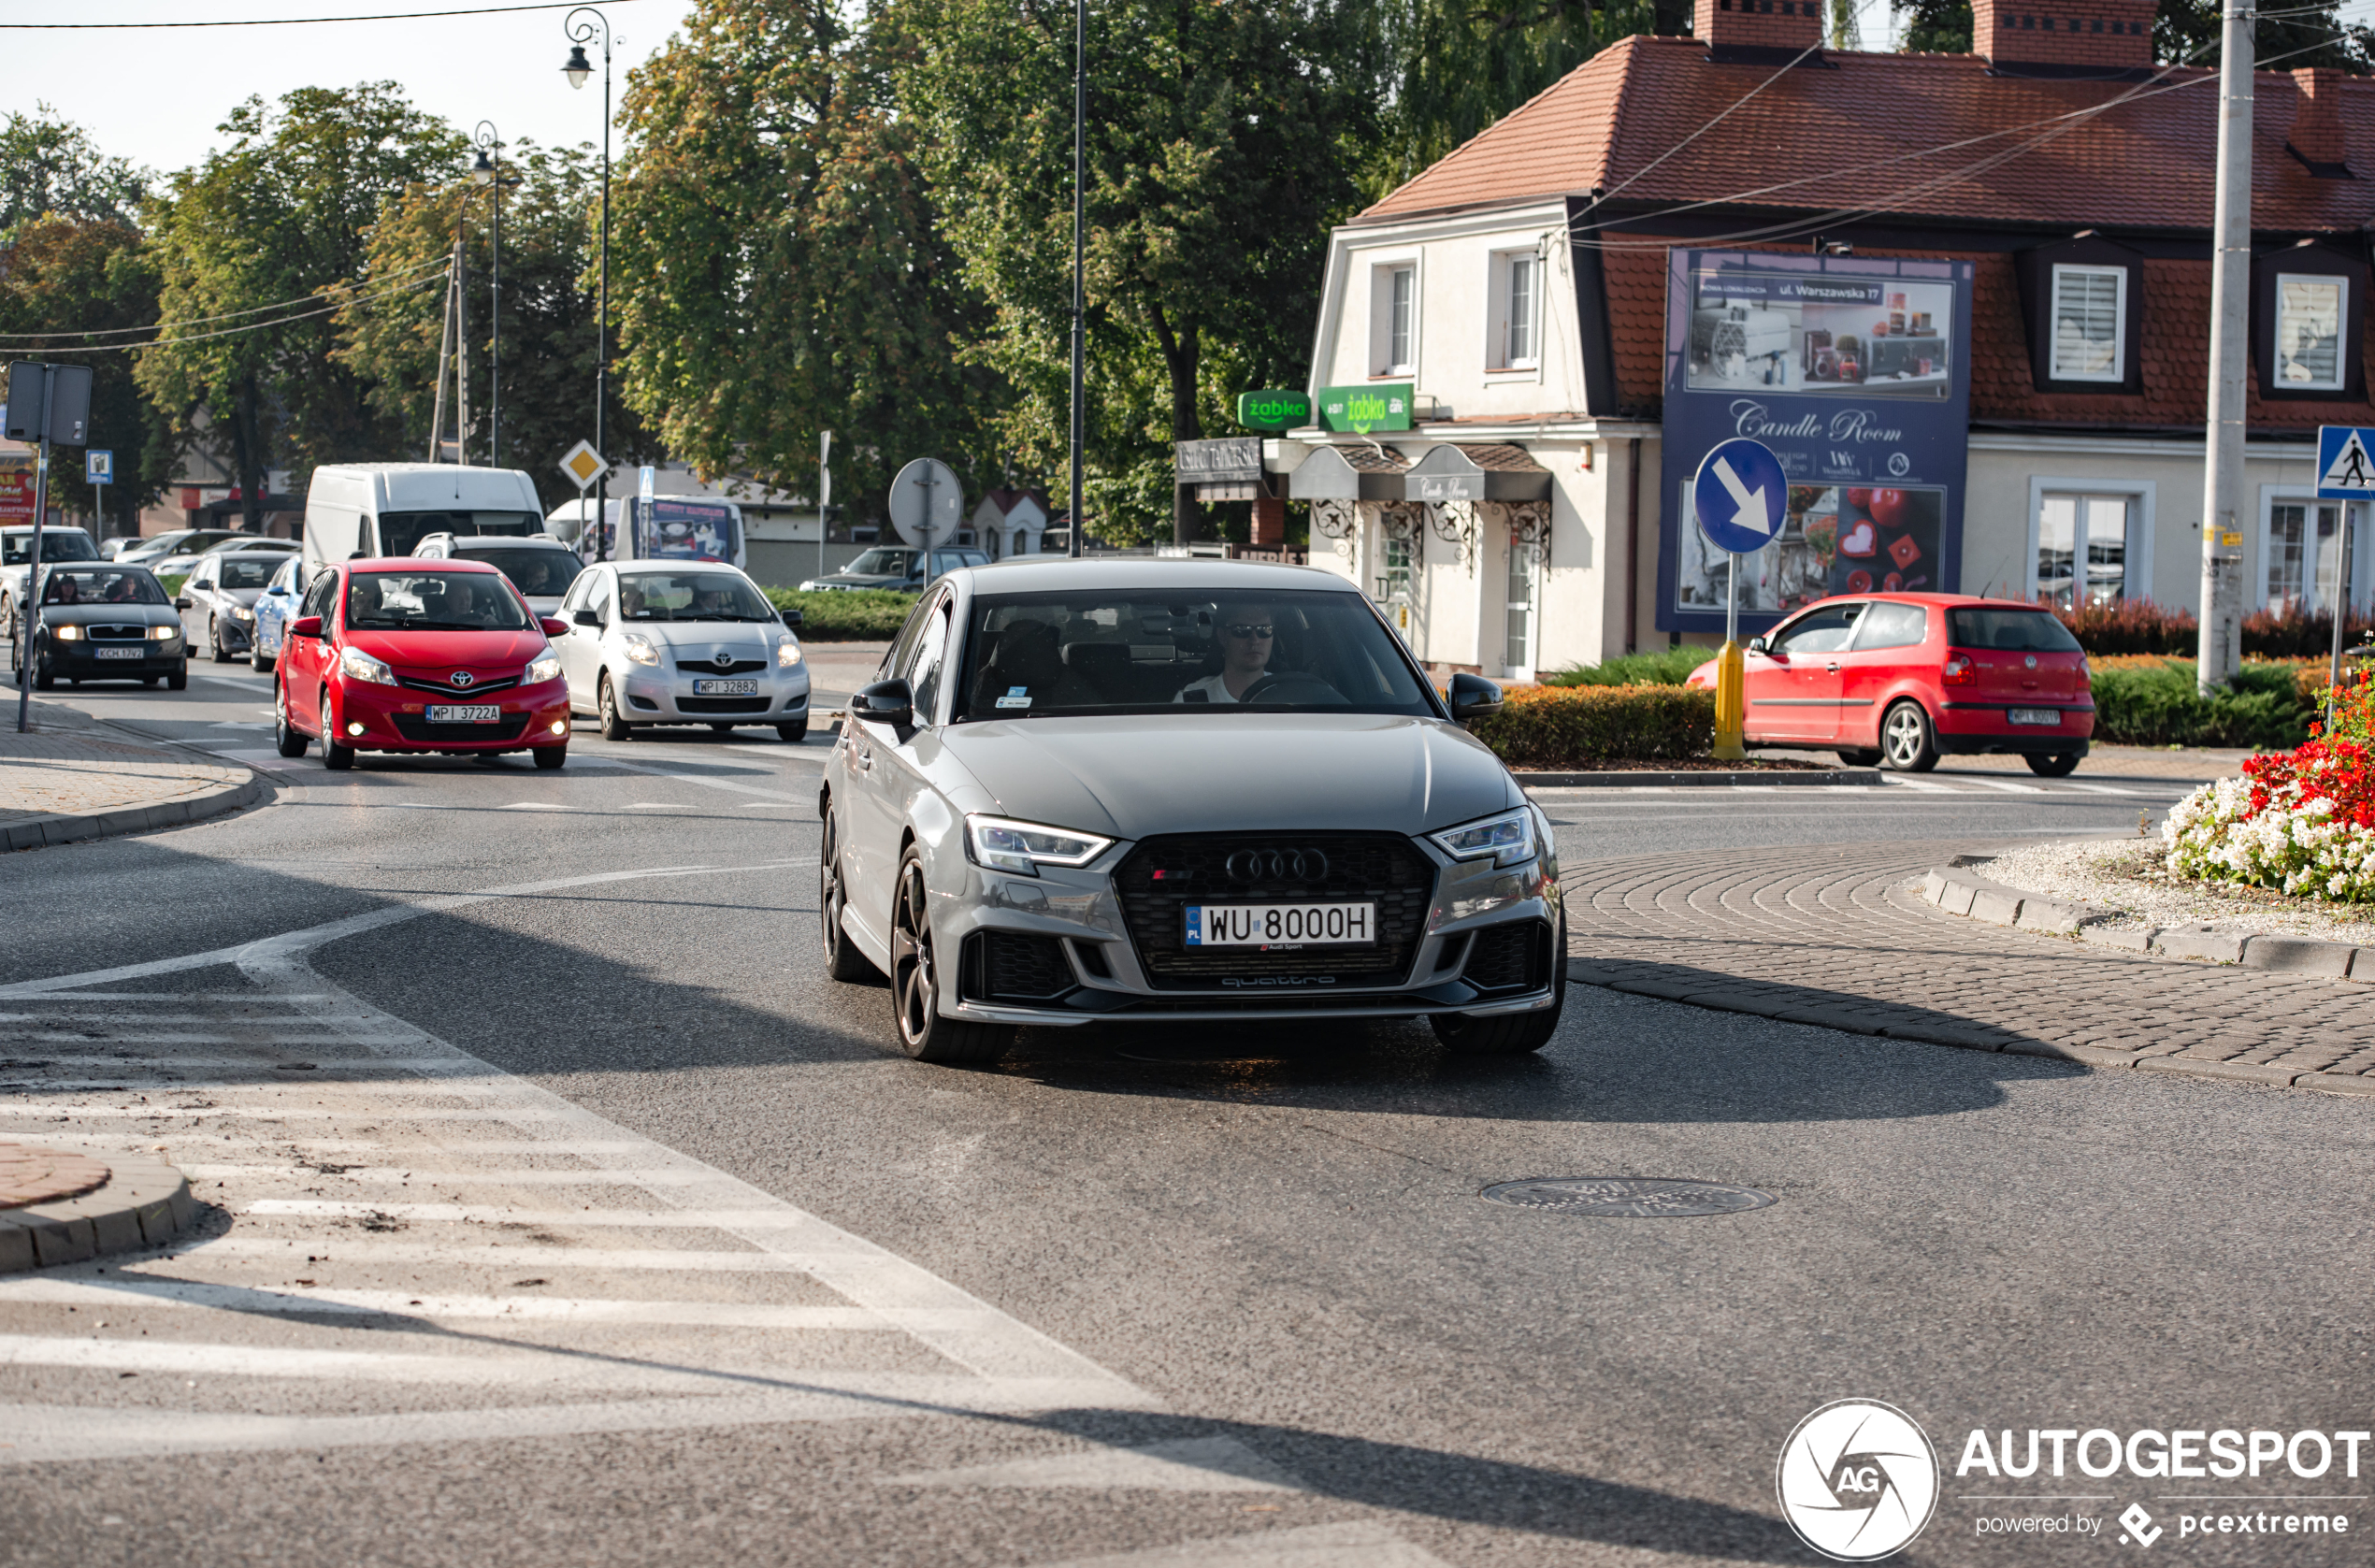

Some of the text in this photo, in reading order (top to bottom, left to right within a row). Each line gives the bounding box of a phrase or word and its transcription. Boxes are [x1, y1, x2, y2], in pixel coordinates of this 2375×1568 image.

[1779, 285, 1879, 299] ul. Warszawska 17
[1249, 399, 1306, 416] żabka
[1347, 393, 1386, 421] żabka
[1730, 398, 1904, 444] Candle Room
[700, 682, 718, 692] WPI
[724, 681, 756, 692] 32882
[433, 707, 498, 720] WPI 3722A
[1209, 907, 1366, 941] WU 8000H
[1188, 930, 1201, 939] PL
[1221, 975, 1336, 987] quattro
